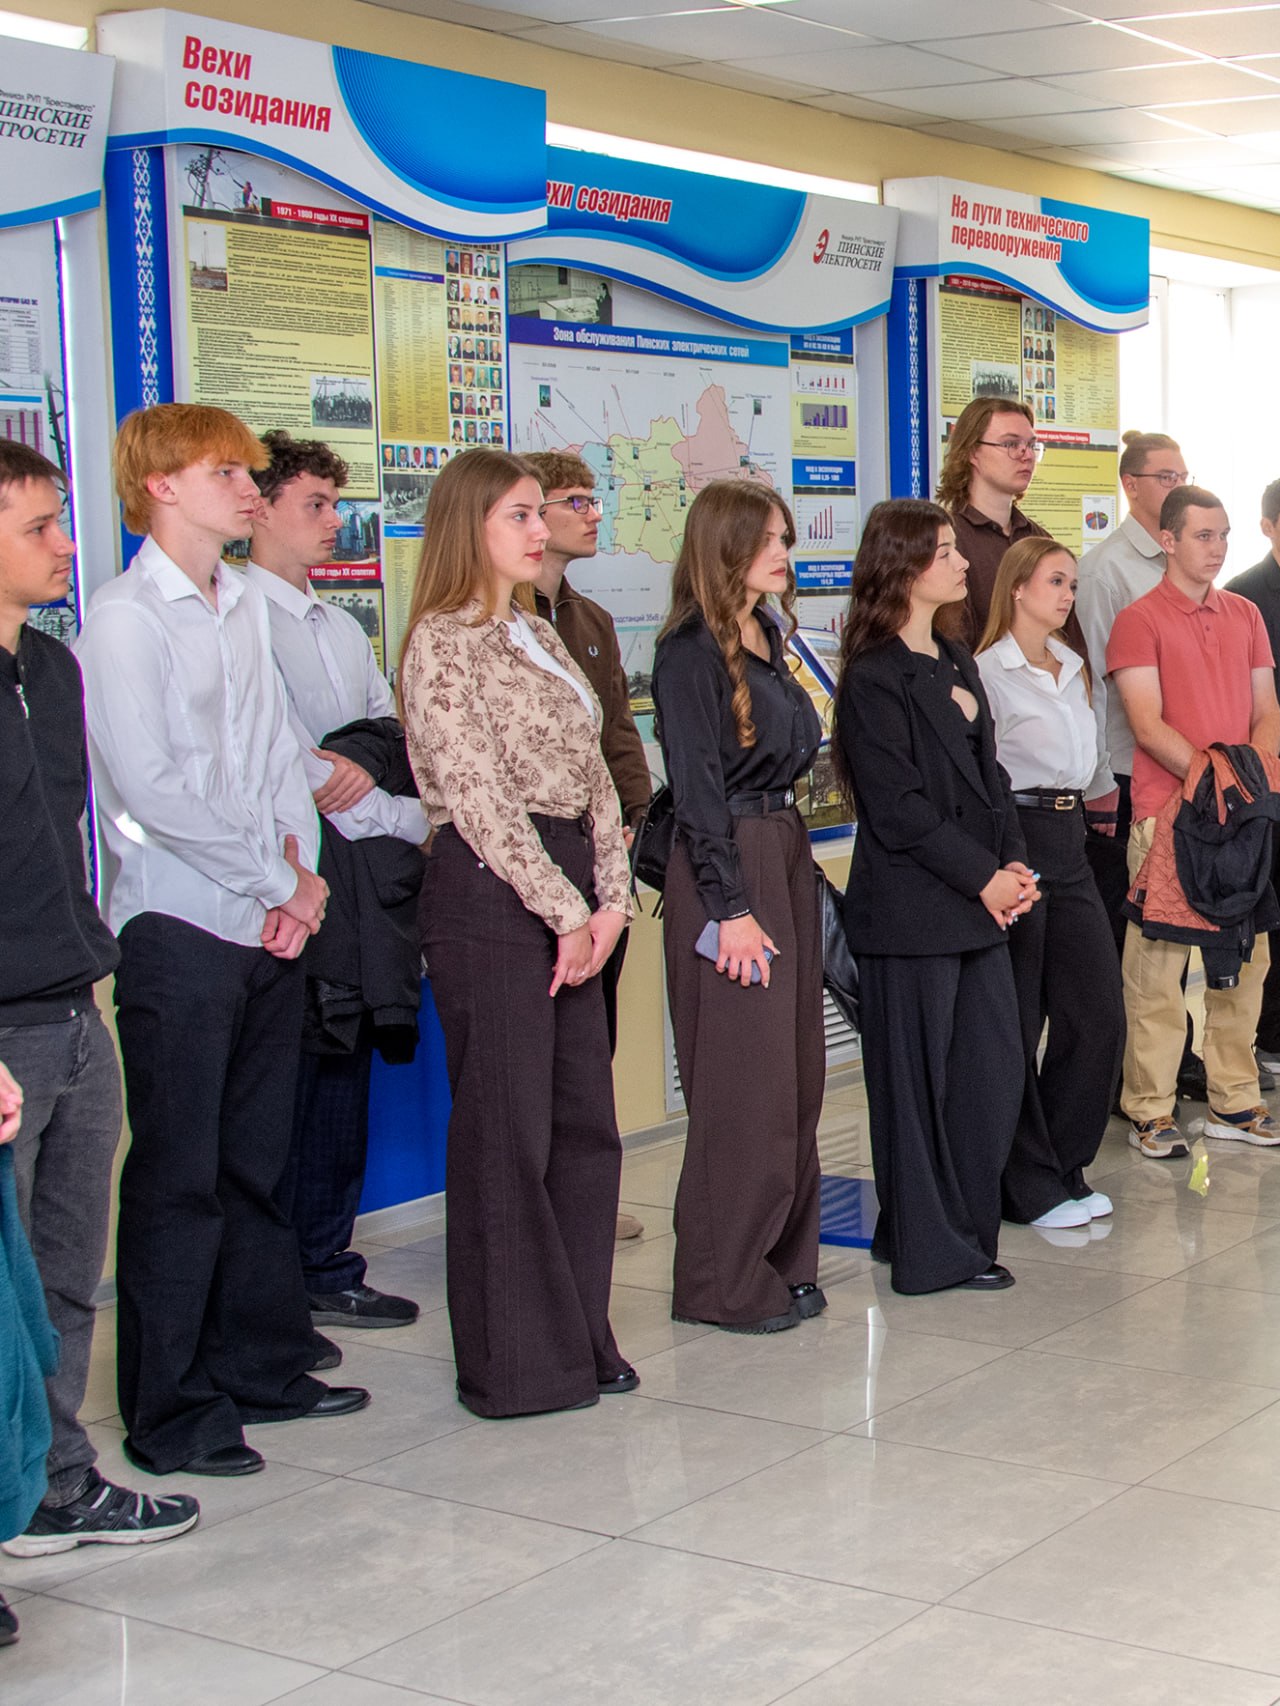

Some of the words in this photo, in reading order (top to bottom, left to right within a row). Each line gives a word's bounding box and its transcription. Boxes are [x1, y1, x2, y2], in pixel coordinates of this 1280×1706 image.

[183, 35, 252, 81] Вехи
[184, 81, 332, 133] созидания
[576, 186, 672, 223] созидания
[951, 194, 968, 219] На
[972, 203, 1002, 226] пути
[1006, 209, 1089, 242] технического
[837, 241, 885, 259] ПИНСКИЕ
[951, 225, 1061, 262] перевооружения
[553, 326, 574, 342] Зона
[575, 328, 635, 347] обслуживания
